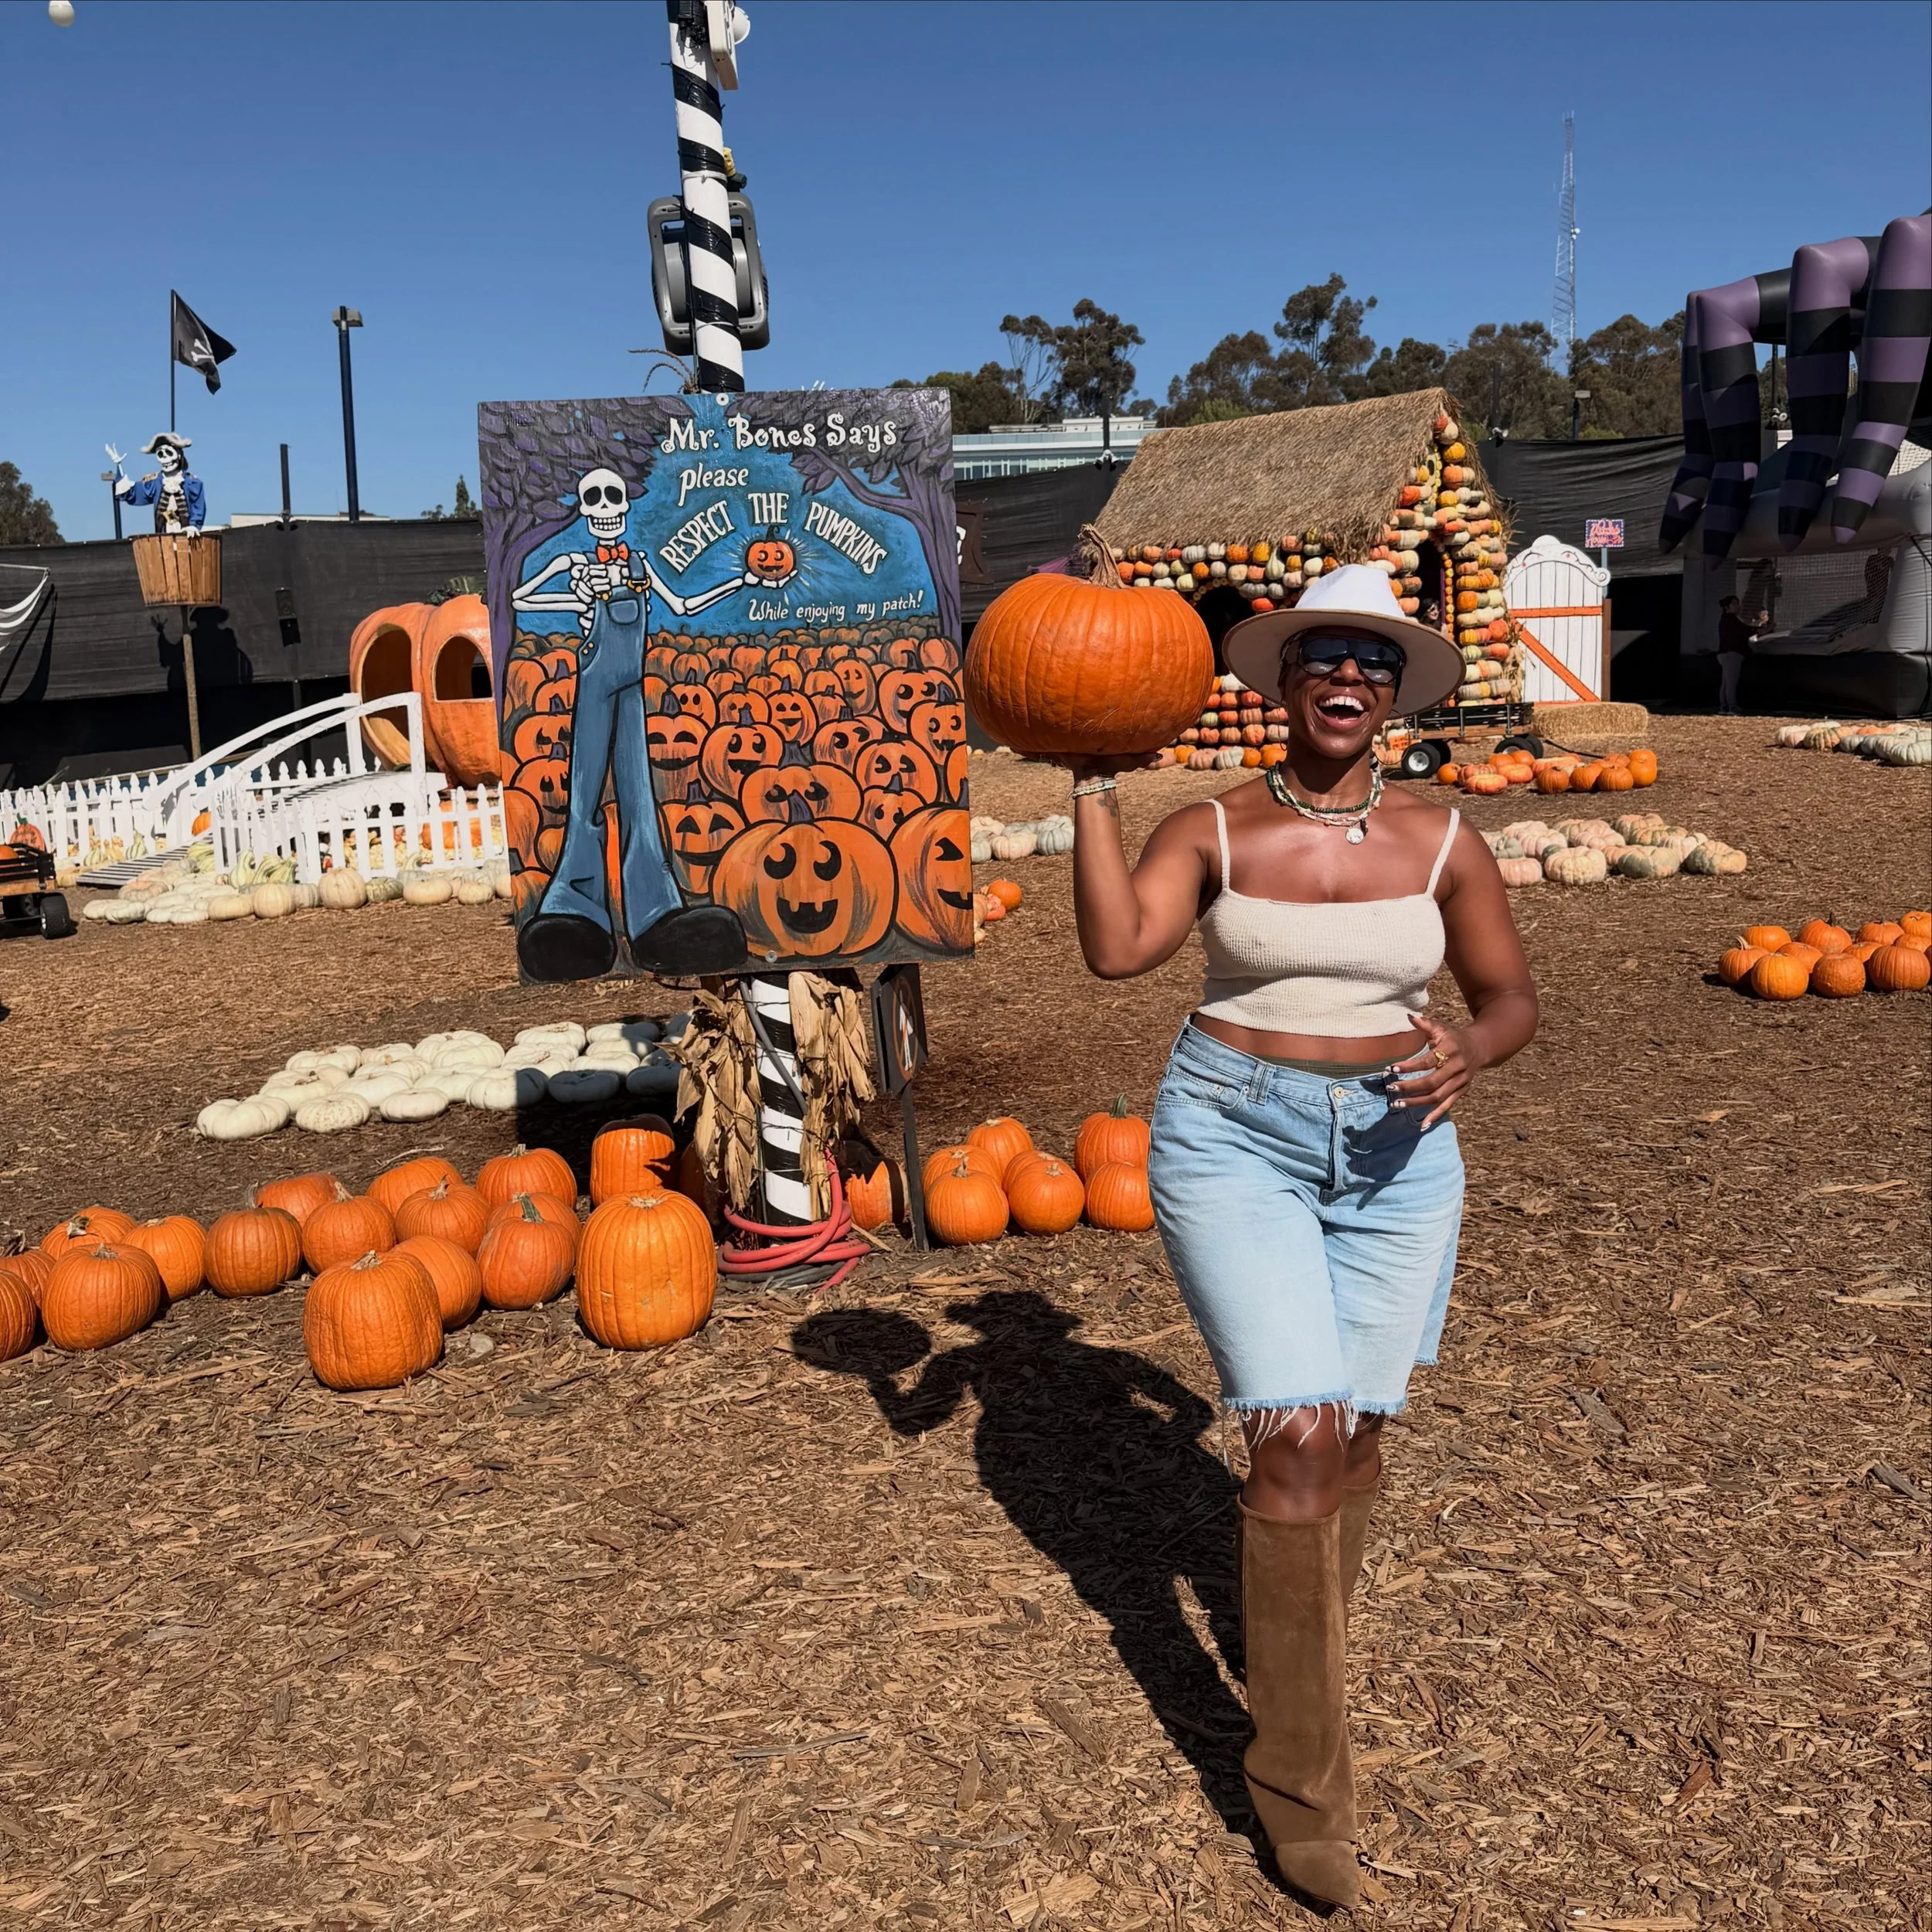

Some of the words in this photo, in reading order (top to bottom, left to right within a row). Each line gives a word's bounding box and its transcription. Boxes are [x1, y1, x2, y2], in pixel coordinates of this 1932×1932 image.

[661, 418, 719, 454] Mr.
[728, 412, 816, 450] Bones
[826, 411, 896, 453] Says
[678, 462, 749, 506] please
[659, 500, 735, 573] RESPECT
[748, 492, 789, 524] THE
[804, 501, 887, 575] PUMPKINS
[749, 598, 788, 621] While
[796, 601, 845, 623] enjoying
[856, 603, 875, 621] my
[882, 590, 923, 617] patch!
